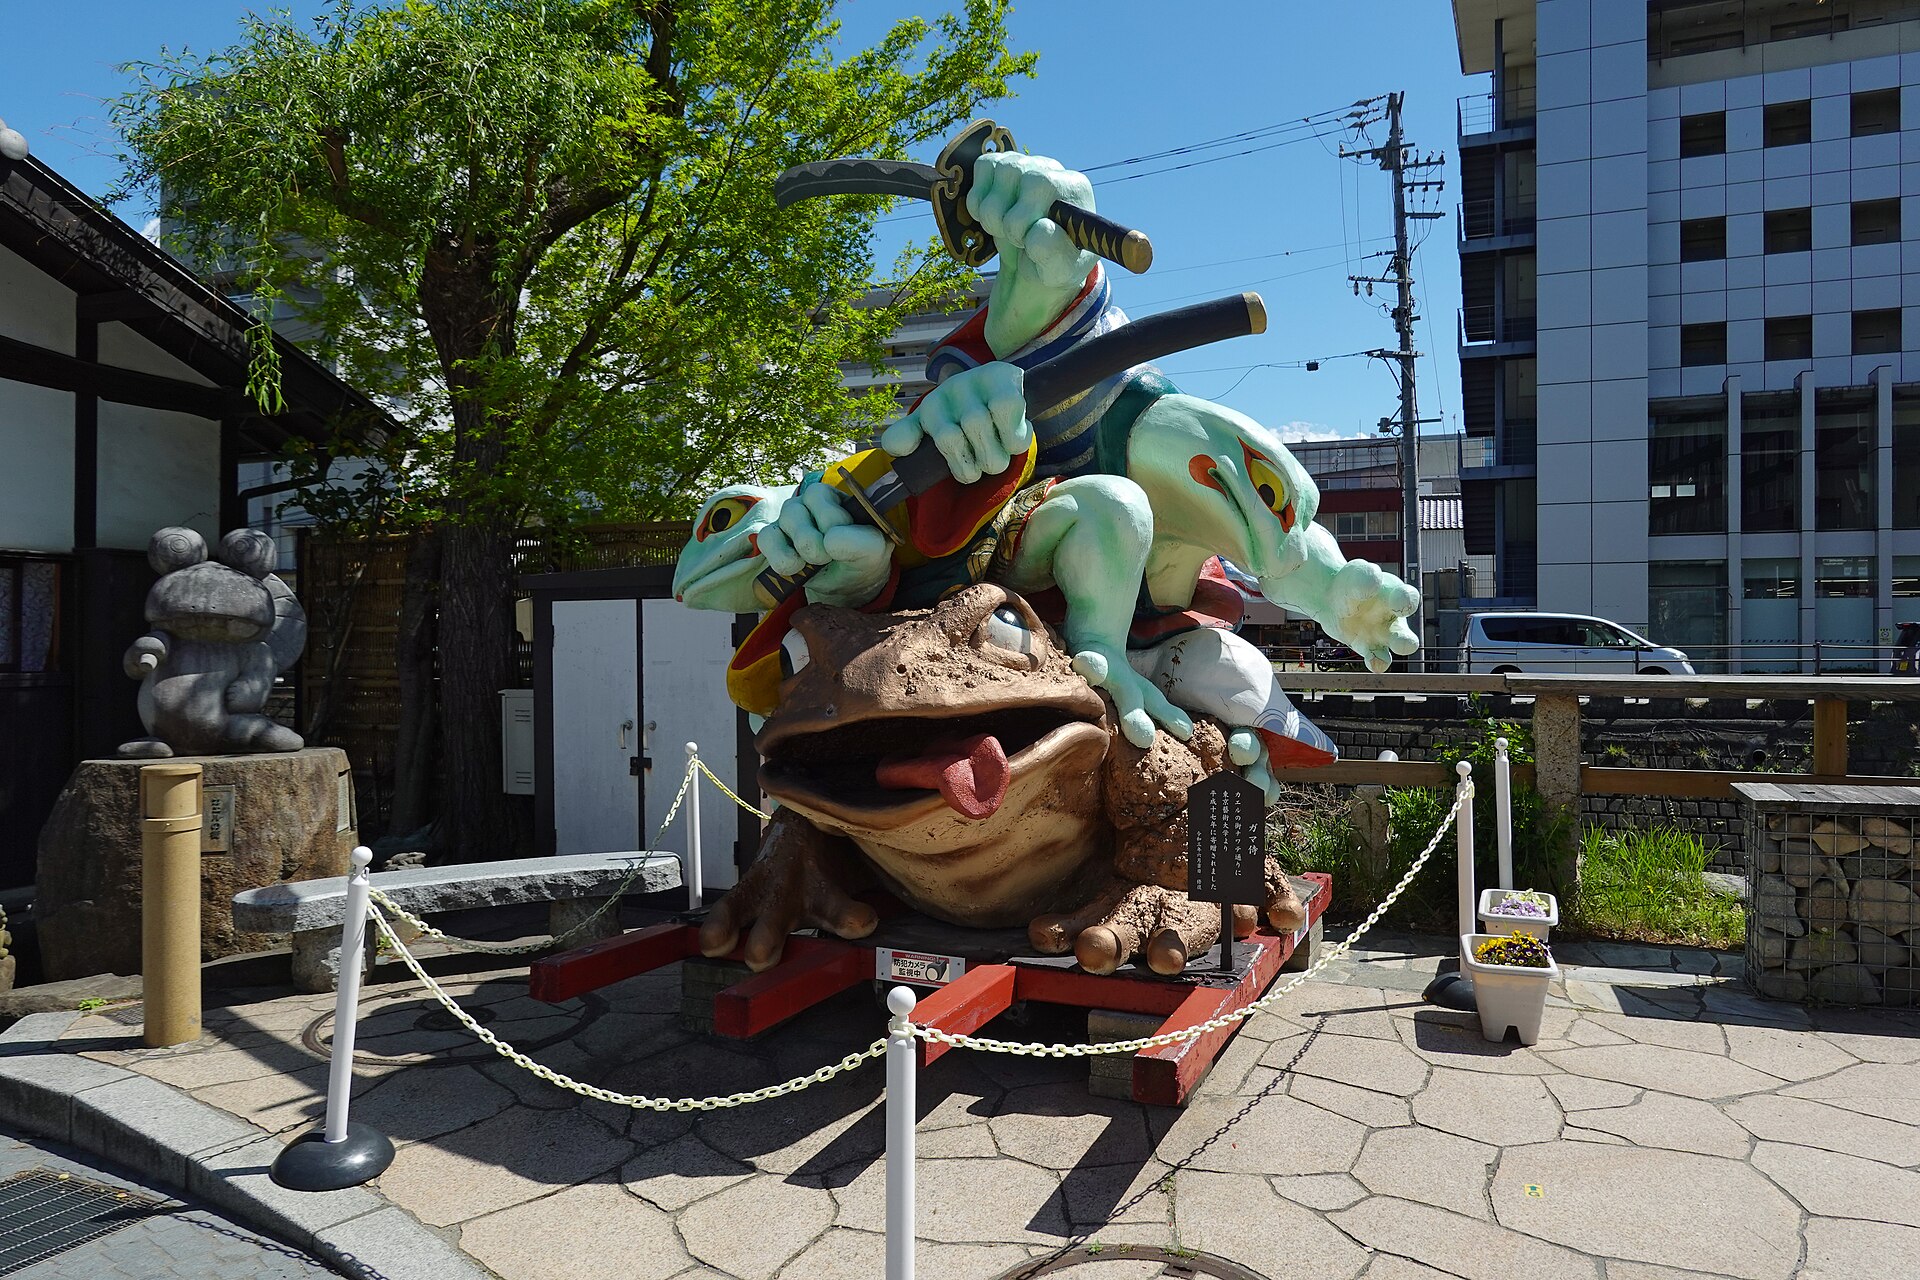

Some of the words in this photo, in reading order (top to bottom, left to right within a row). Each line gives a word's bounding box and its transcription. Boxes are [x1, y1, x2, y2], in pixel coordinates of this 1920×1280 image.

[1209, 790, 1217, 891] 平成十七年に寄贈されました
[1247, 822, 1259, 856] ガマ侍
[893, 958, 926, 970] 防犯カメラ
[898, 967, 921, 977] 監視中
